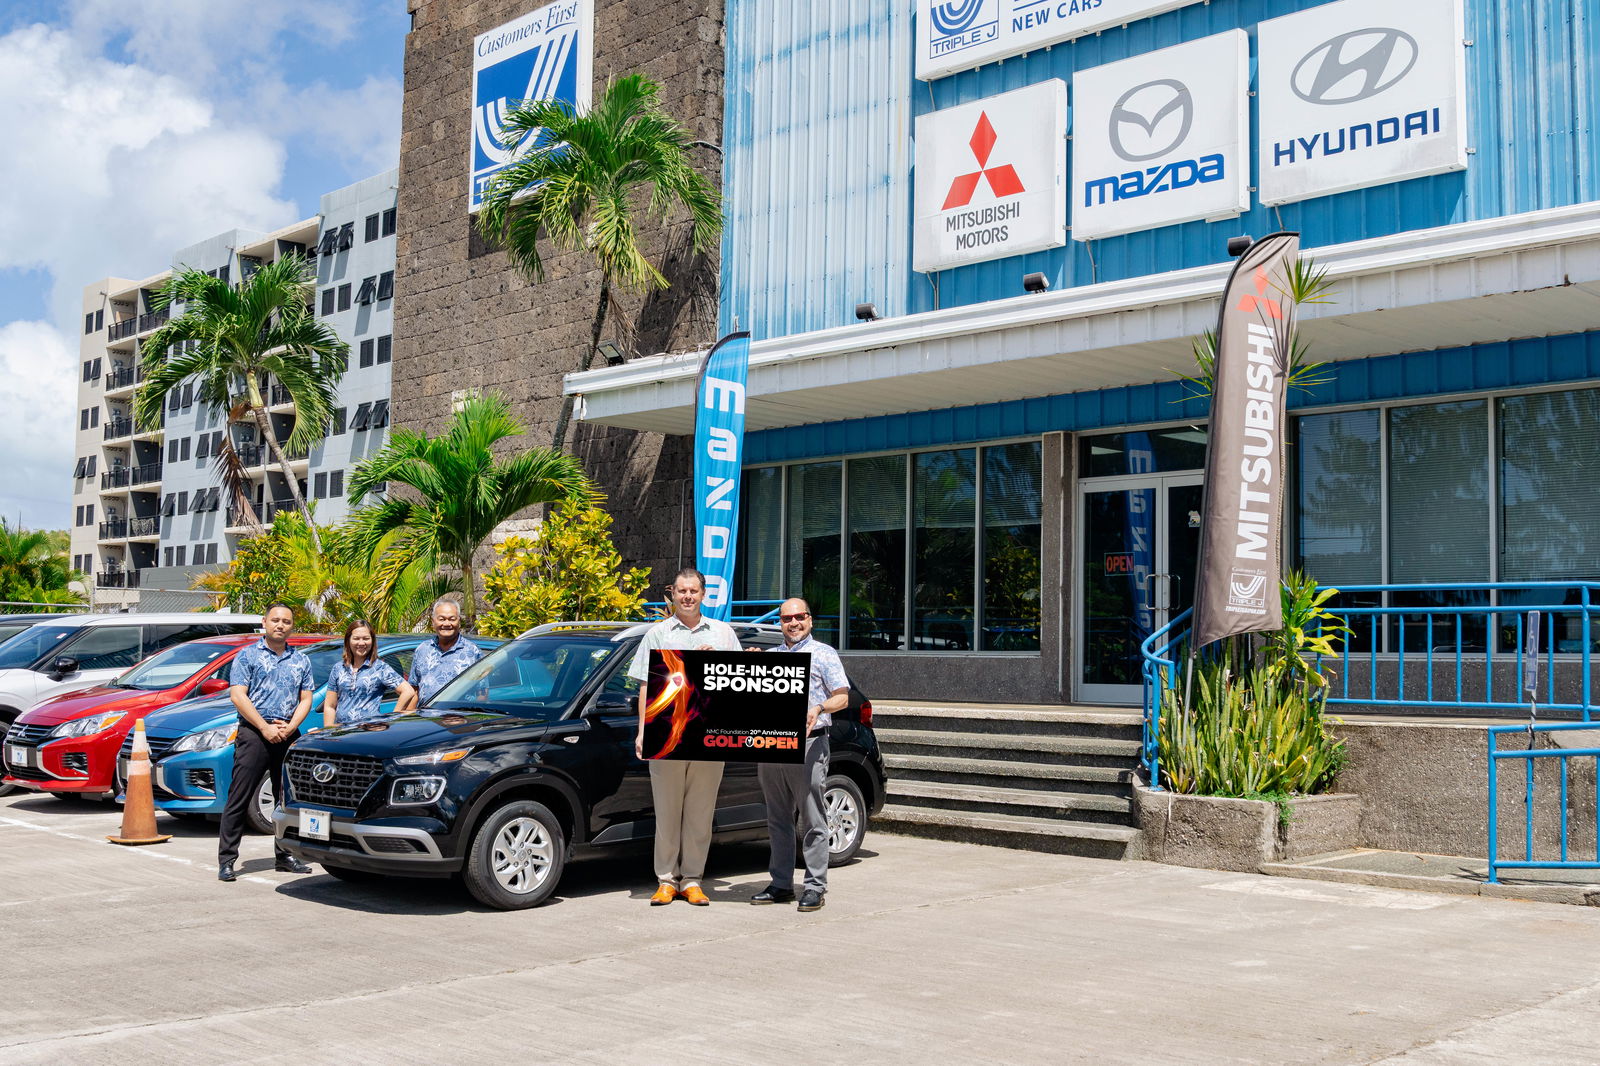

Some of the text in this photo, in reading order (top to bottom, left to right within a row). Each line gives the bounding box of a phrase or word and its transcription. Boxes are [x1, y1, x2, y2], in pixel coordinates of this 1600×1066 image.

[478, 2, 577, 57] Customers First
[1012, 8, 1050, 33] NEW
[933, 25, 996, 54] TRIPLE J
[1273, 107, 1440, 167] HYUNDAI
[946, 201, 1020, 232] MITSUBISHI
[956, 225, 1009, 250] MOTORS
[1236, 323, 1274, 560] MITSUBISHI
[1106, 556, 1134, 572] OPEN
[704, 663, 805, 678] HOLE-IN-ONE
[703, 676, 804, 694] SPONSOR
[703, 735, 798, 749] GOLF OPEN
[762, 729, 798, 737] Anniversary
